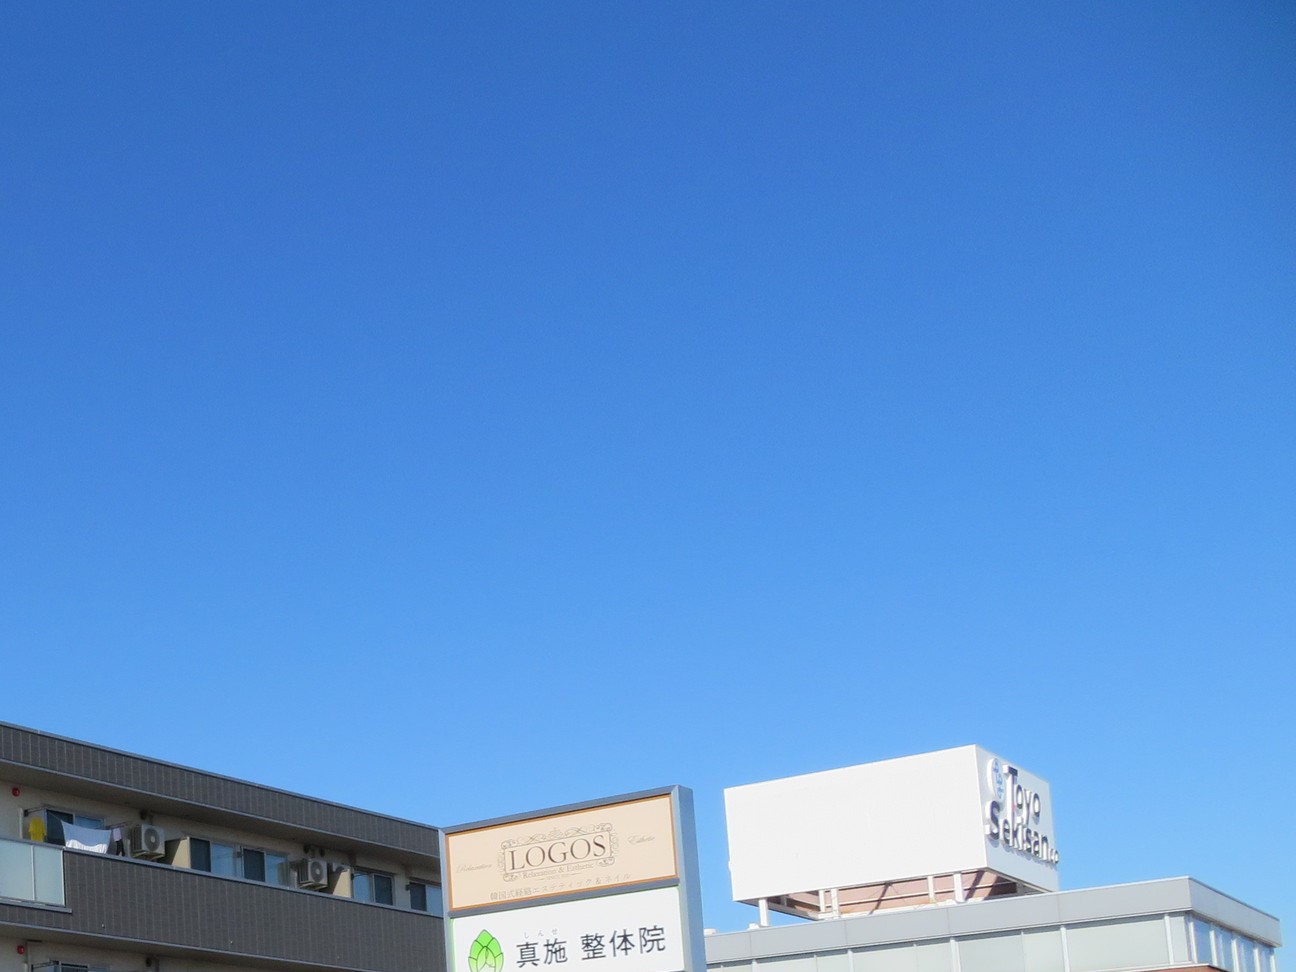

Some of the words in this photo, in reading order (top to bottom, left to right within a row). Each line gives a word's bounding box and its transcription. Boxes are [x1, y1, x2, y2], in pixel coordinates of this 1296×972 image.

[1003, 764, 1040, 826] Toyo
[509, 834, 607, 871] LOGOS
[985, 800, 1049, 861] Sekisan
[516, 937, 569, 969] 真施
[580, 924, 667, 961] 整体院
